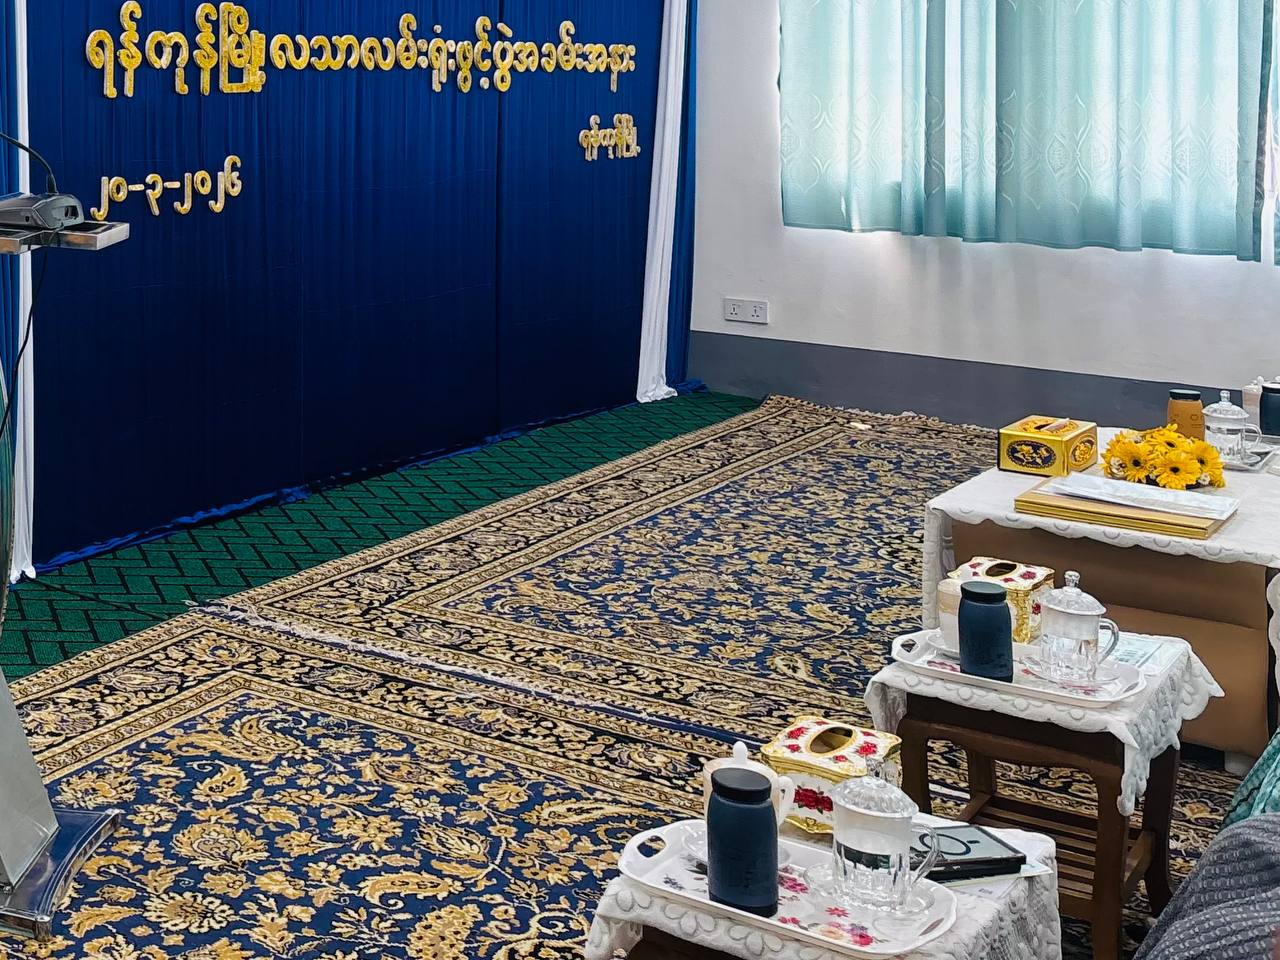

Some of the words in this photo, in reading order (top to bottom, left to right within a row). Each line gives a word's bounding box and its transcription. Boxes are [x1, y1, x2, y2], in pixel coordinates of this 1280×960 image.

[578, 113, 642, 162] ရန်ကုန်မြို့
[90, 154, 243, 222] ၂၀-၃-၂၀၂၆
